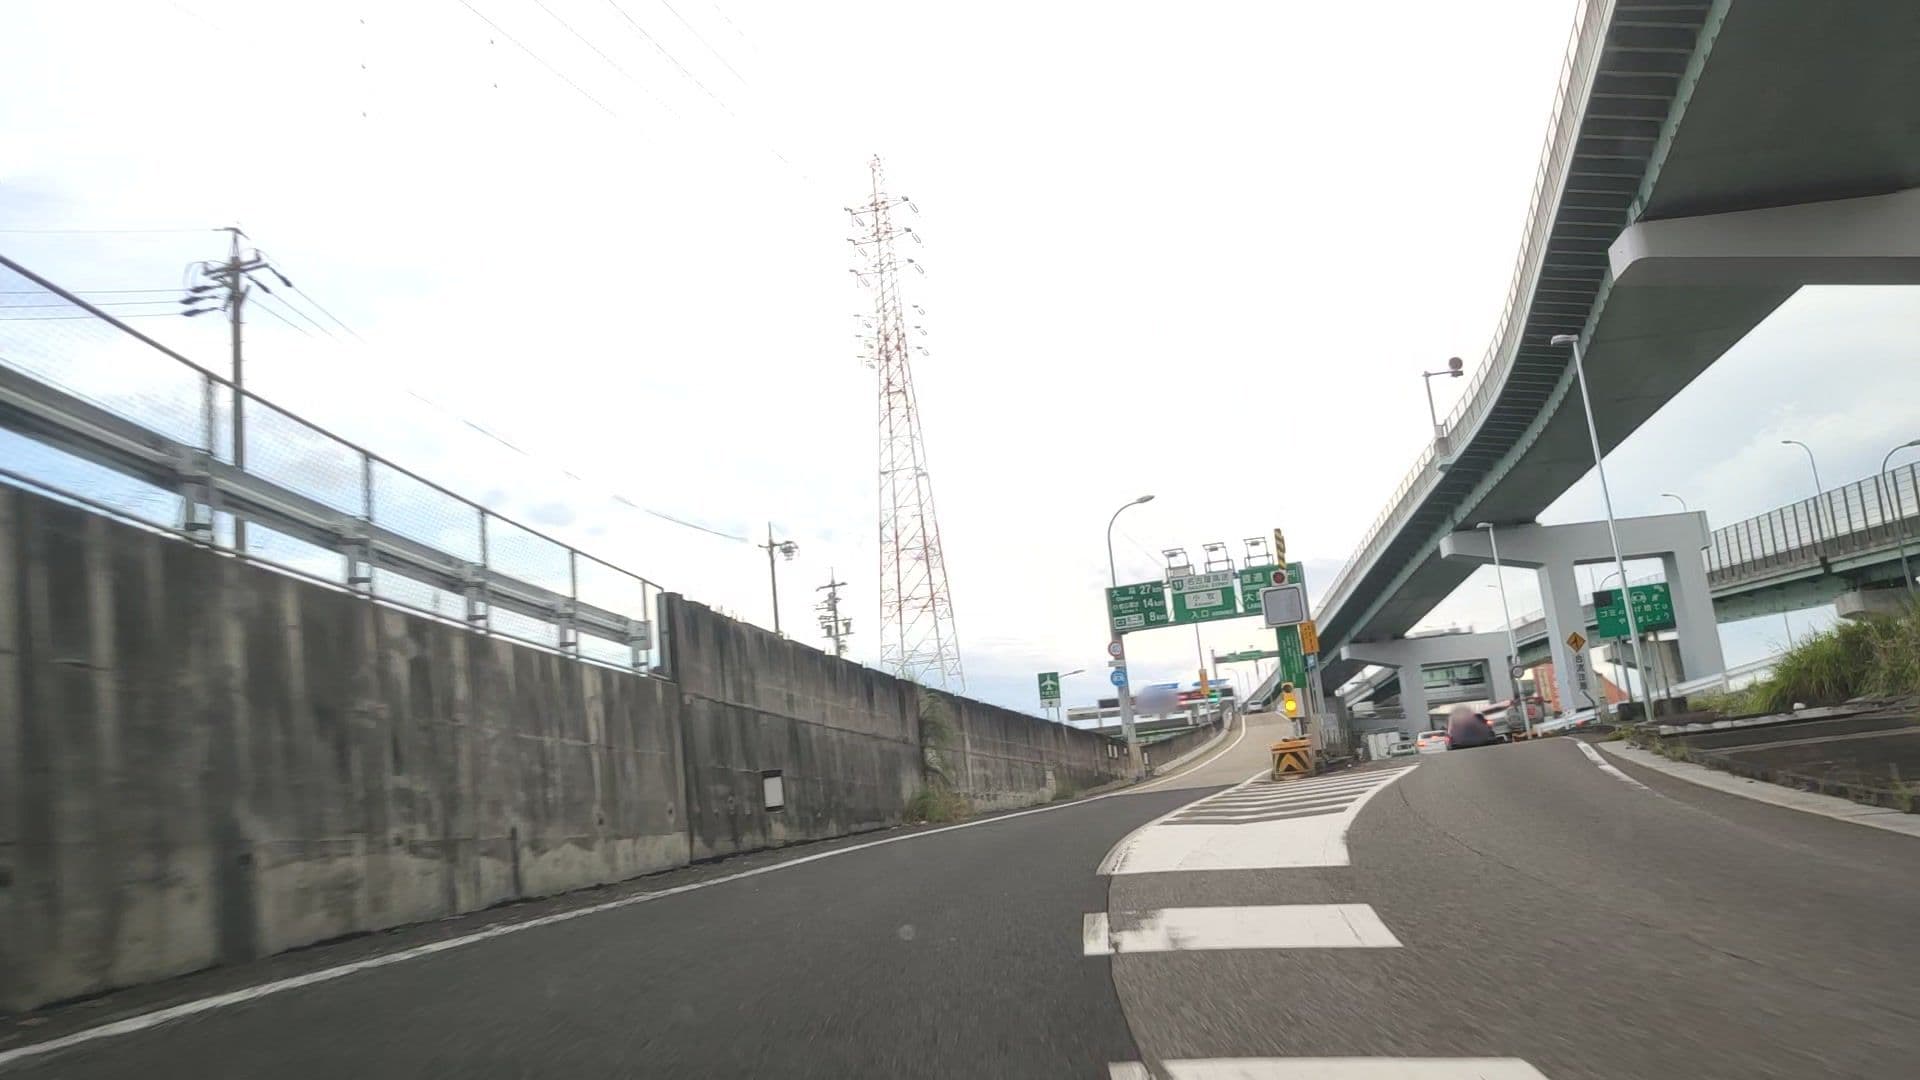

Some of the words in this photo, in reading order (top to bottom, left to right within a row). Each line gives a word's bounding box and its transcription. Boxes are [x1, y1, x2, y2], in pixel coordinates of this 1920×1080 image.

[1191, 609, 1209, 619] 入口
[1599, 602, 1669, 618] ゴミのげ捨ては
